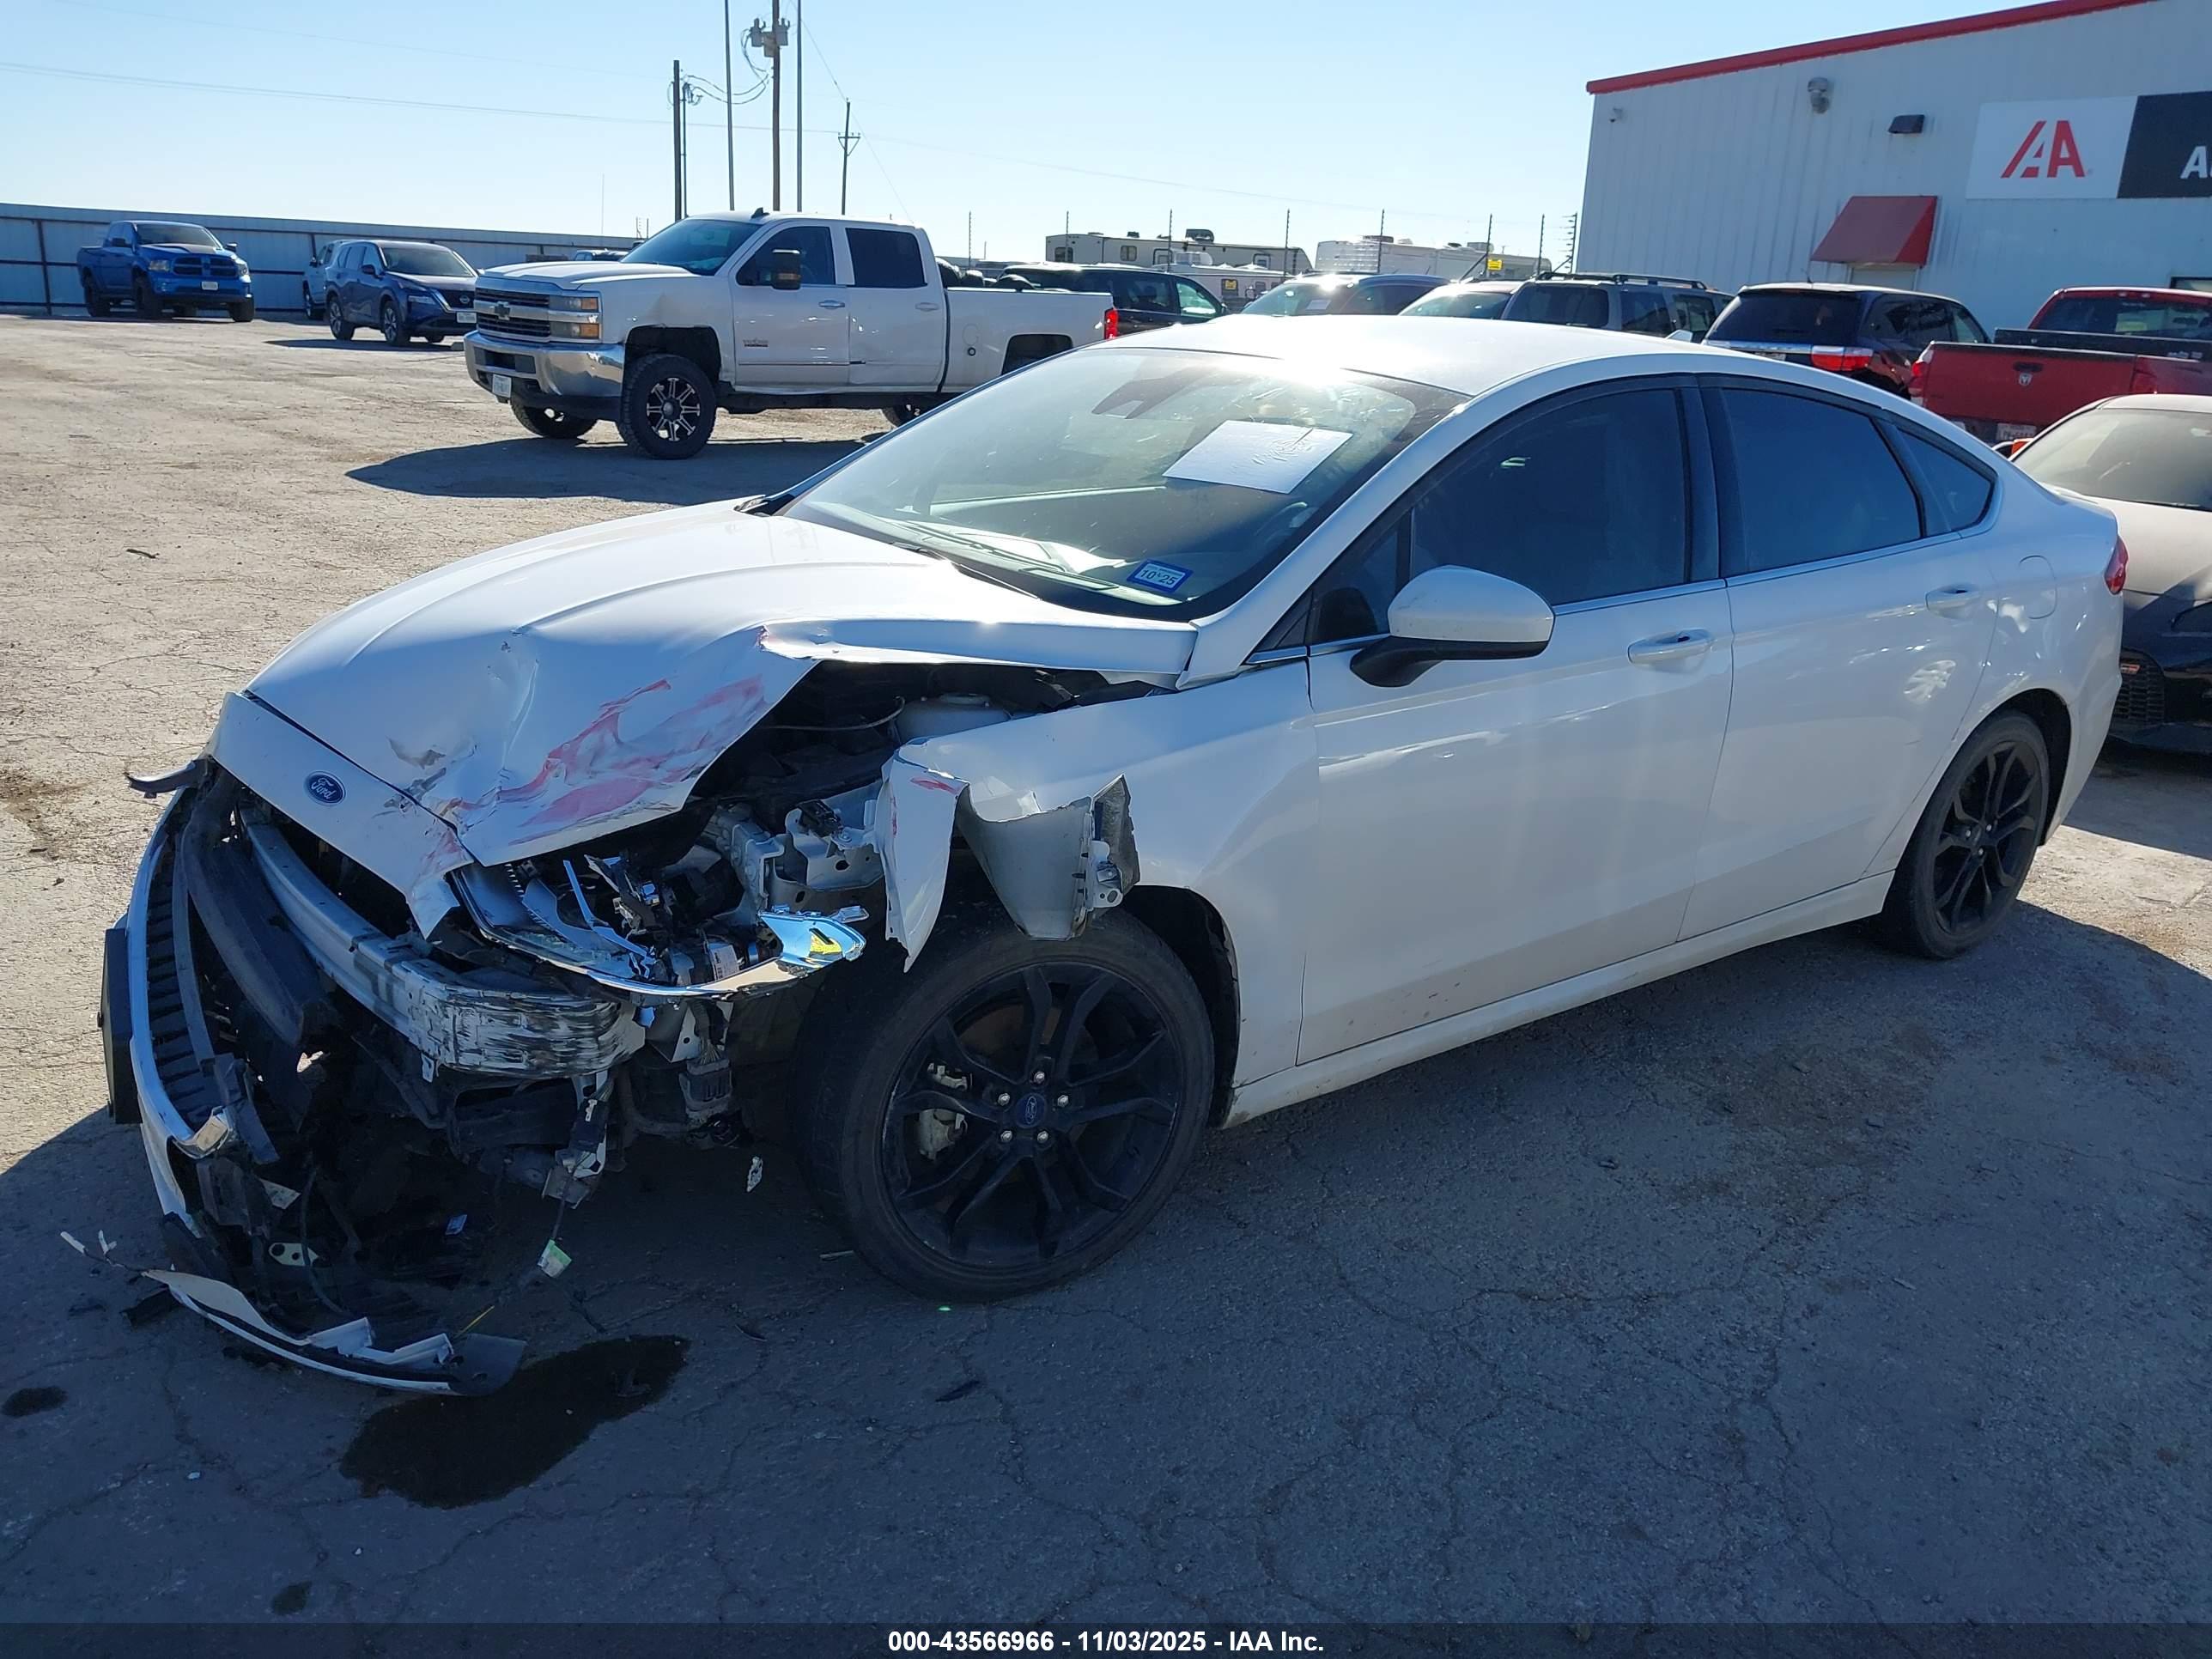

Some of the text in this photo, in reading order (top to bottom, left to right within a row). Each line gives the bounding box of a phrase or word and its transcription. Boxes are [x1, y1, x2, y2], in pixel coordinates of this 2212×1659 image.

[2180, 146, 2212, 179] A
[1141, 570, 1156, 579] 10
[1159, 574, 1178, 585] 25
[311, 777, 337, 799] Ford
